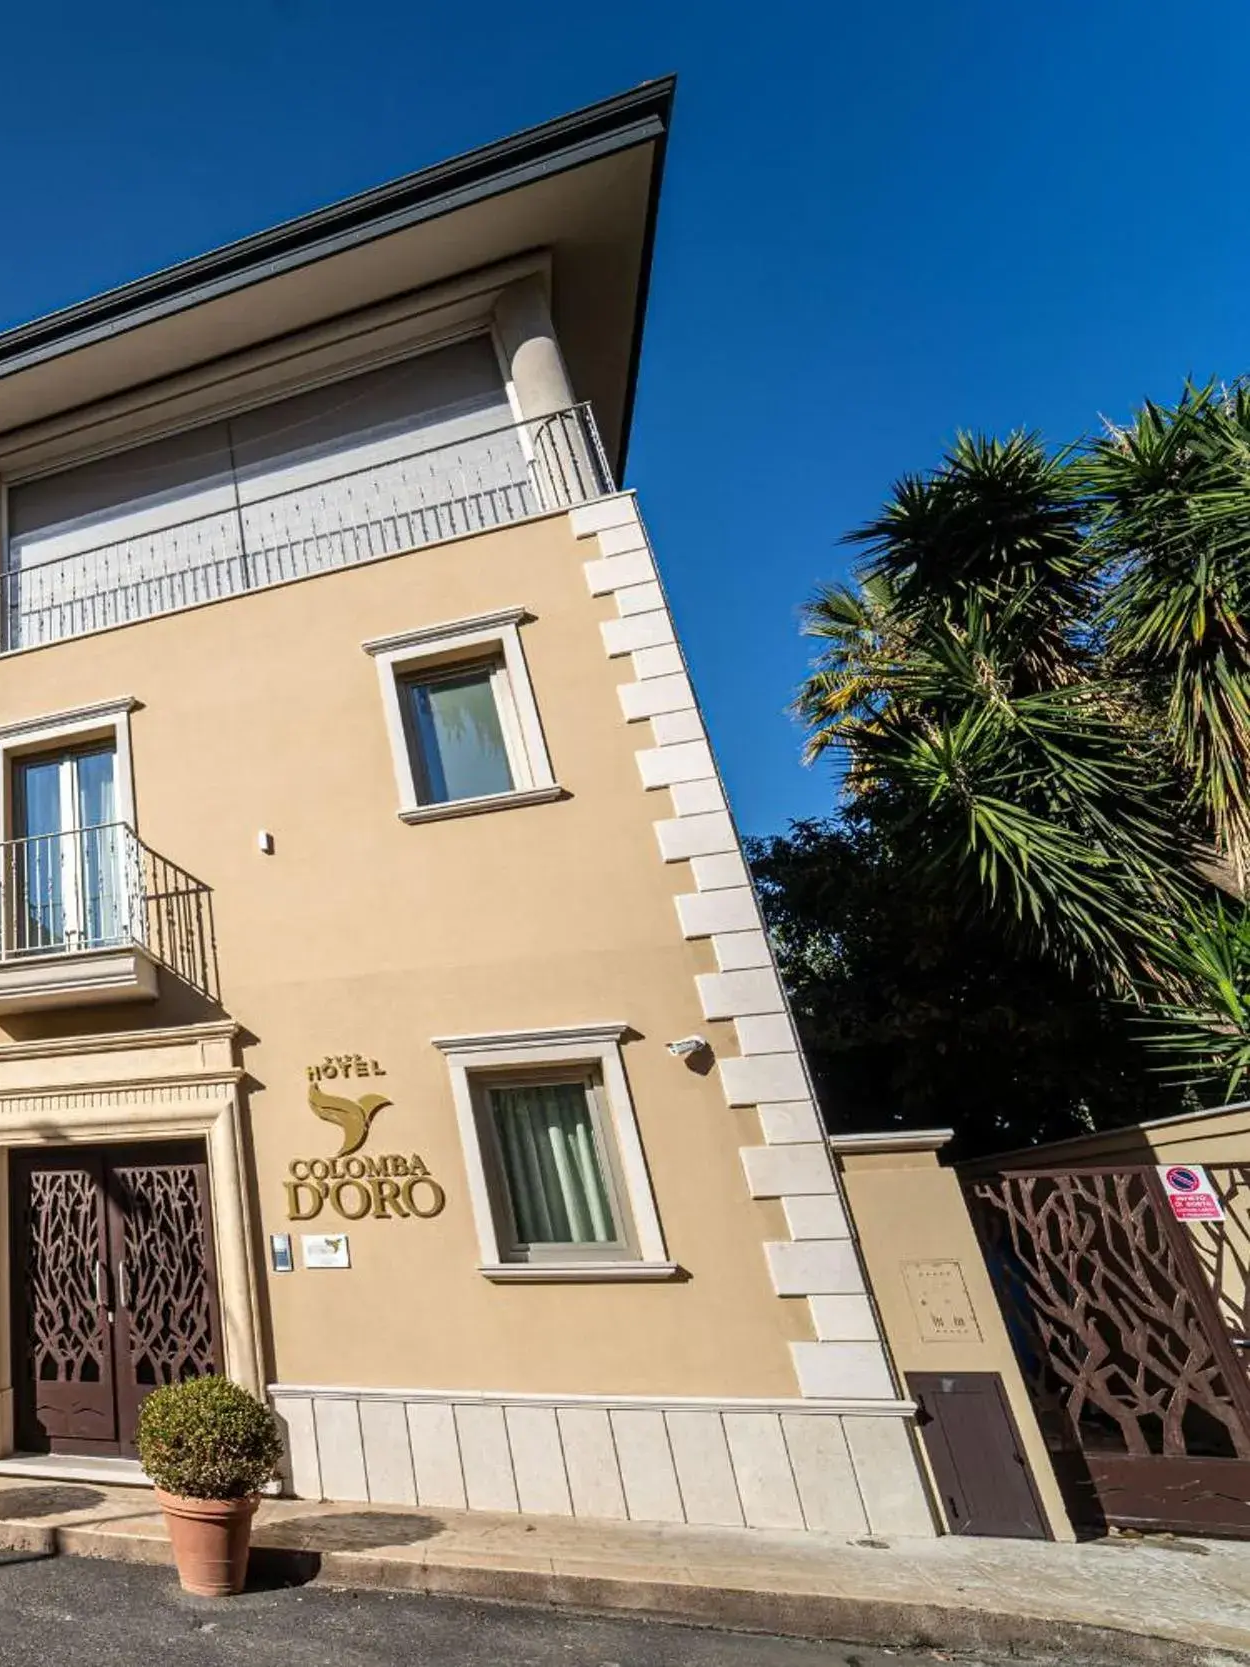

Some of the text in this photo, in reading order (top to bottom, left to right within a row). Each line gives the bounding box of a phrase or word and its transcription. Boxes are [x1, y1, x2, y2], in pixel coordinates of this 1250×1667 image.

[306, 1060, 387, 1081] HOTEL
[288, 1153, 431, 1181] COLOMBA
[283, 1177, 446, 1221] D'ORO
